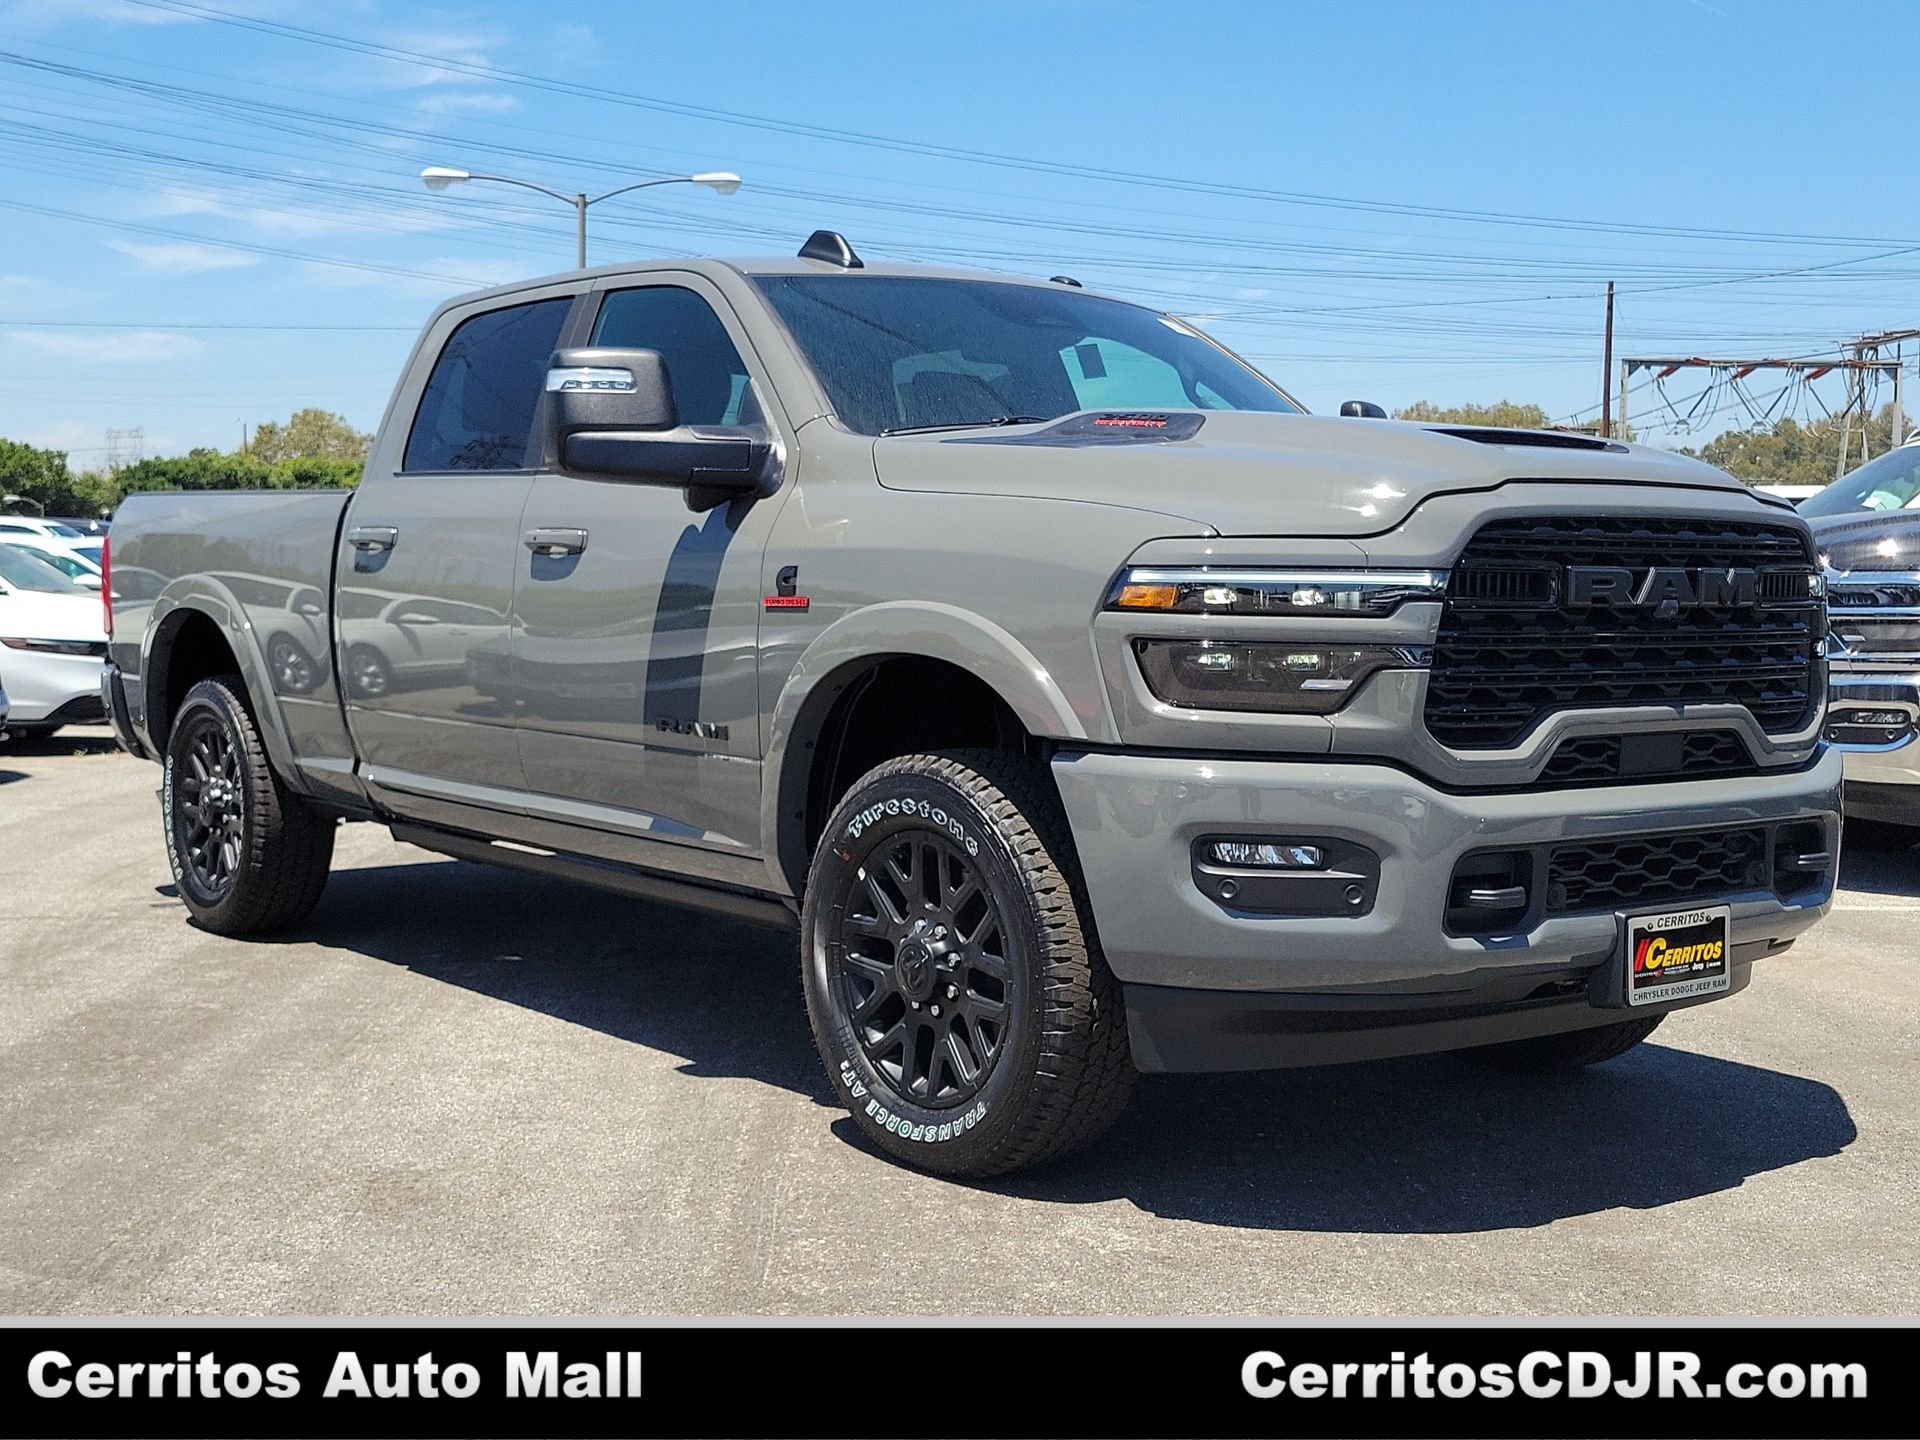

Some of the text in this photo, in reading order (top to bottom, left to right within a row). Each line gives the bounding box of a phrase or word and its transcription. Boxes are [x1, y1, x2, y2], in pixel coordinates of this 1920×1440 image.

[1567, 566, 1756, 606] RAM
[656, 719, 729, 741] RAM
[848, 798, 978, 856] Firestone
[1657, 912, 1705, 928] CERRITOS
[1633, 978, 1727, 1001] CHRYSLER DODGE JEEP RAM
[865, 1099, 986, 1143] TRANSFORCE
